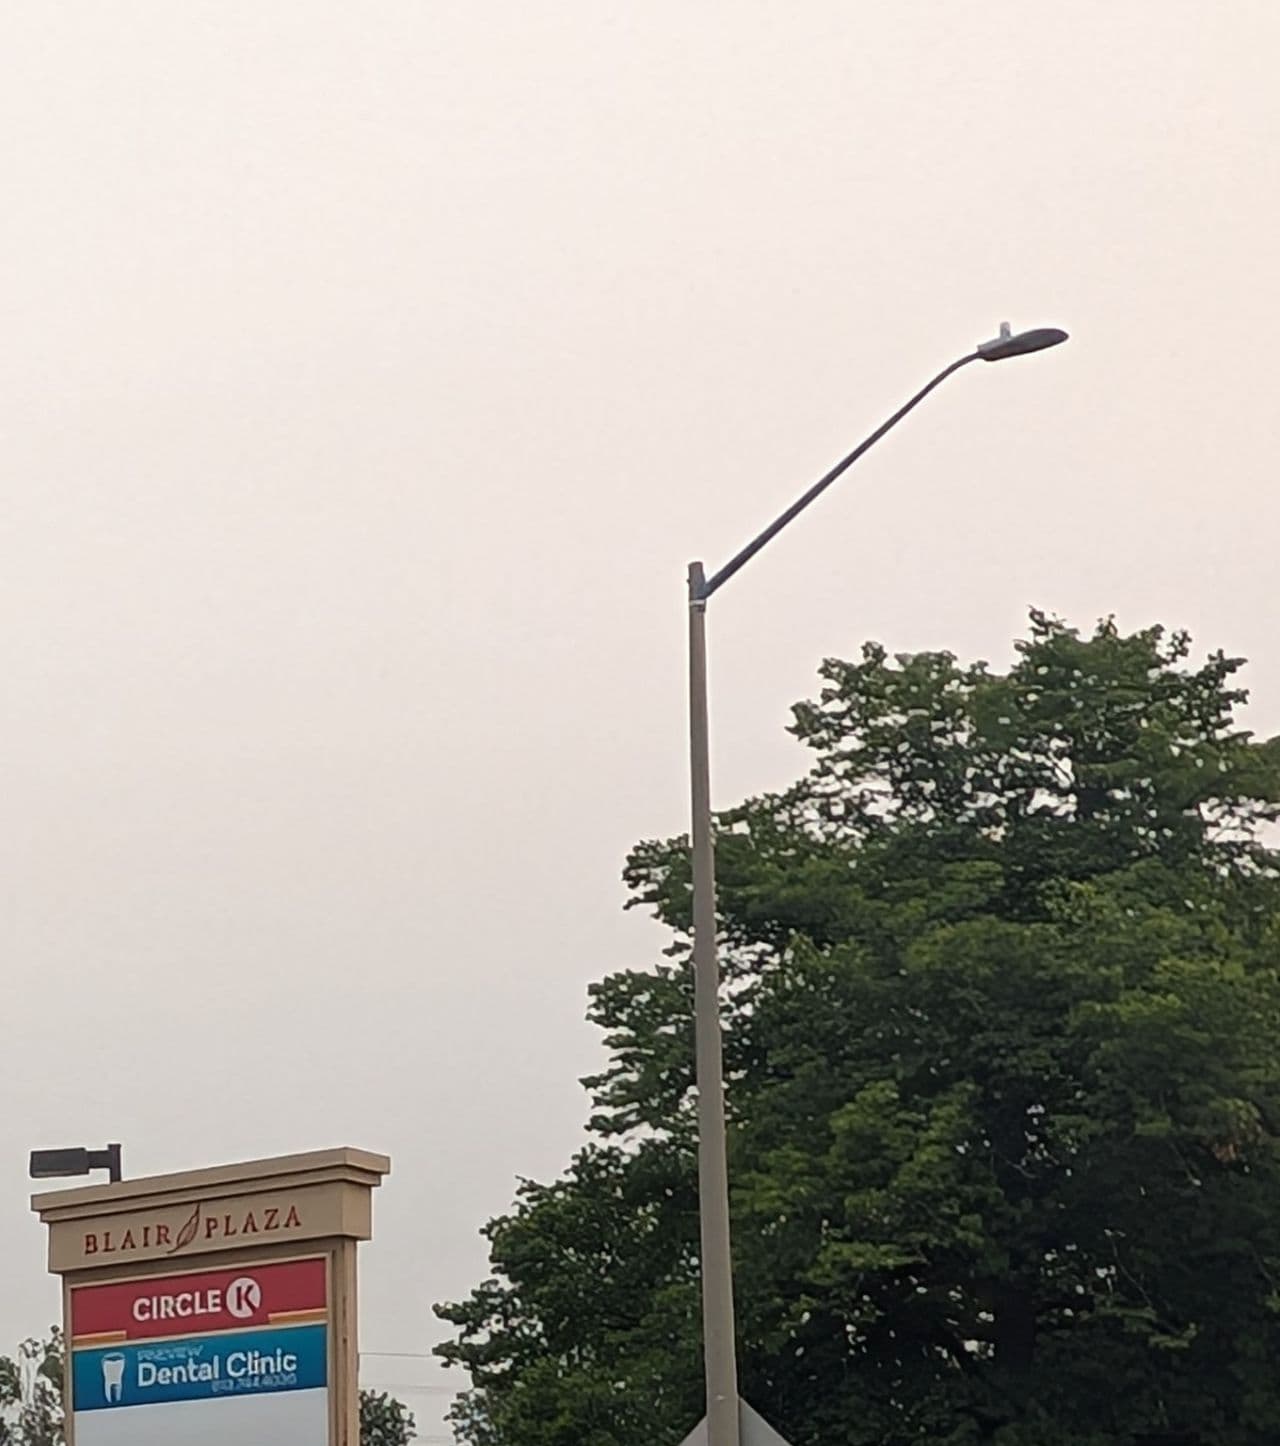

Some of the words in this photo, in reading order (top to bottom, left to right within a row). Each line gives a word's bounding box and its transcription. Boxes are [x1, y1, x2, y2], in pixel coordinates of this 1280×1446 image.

[85, 1224, 171, 1254] BLAIR
[204, 1205, 302, 1239] PLAZA
[132, 1289, 222, 1322] CIRCLE
[230, 1281, 261, 1316] K
[137, 1354, 220, 1387] Dental
[226, 1348, 298, 1378] Clinic
